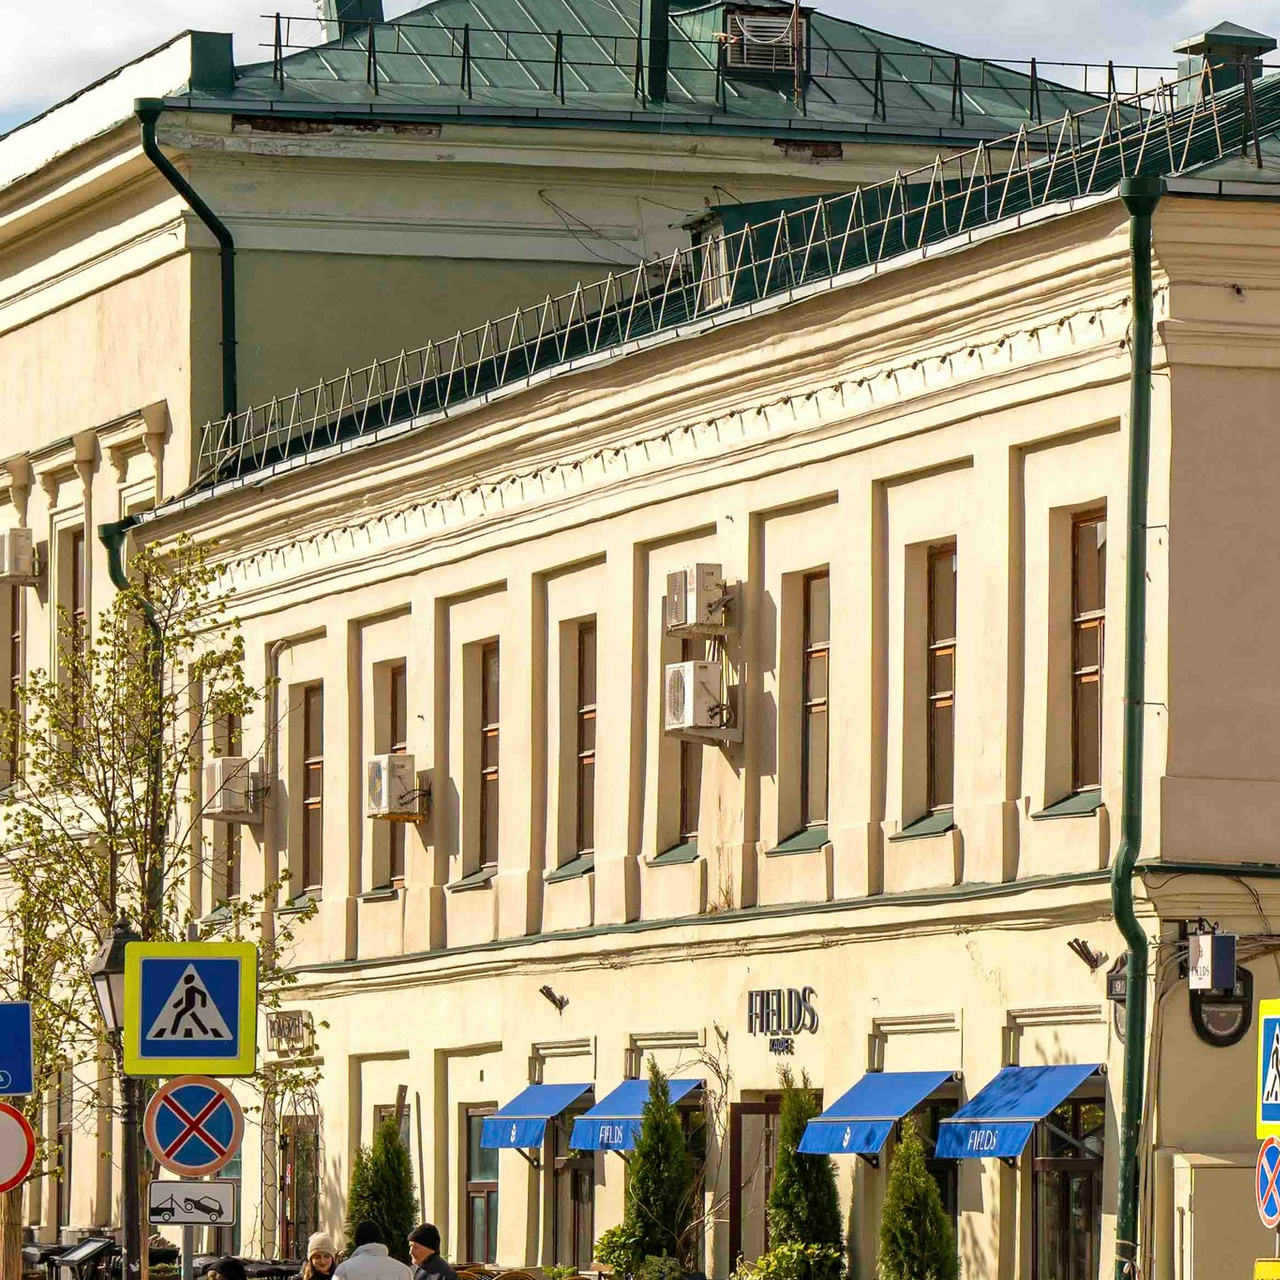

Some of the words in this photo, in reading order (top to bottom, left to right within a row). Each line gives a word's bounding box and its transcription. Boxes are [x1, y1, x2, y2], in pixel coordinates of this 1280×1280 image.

[1191, 965, 1210, 976] FIELDS
[748, 986, 818, 1035] FIELDS
[598, 1125, 623, 1144] FIELDS
[967, 1130, 999, 1150] FIELDS
